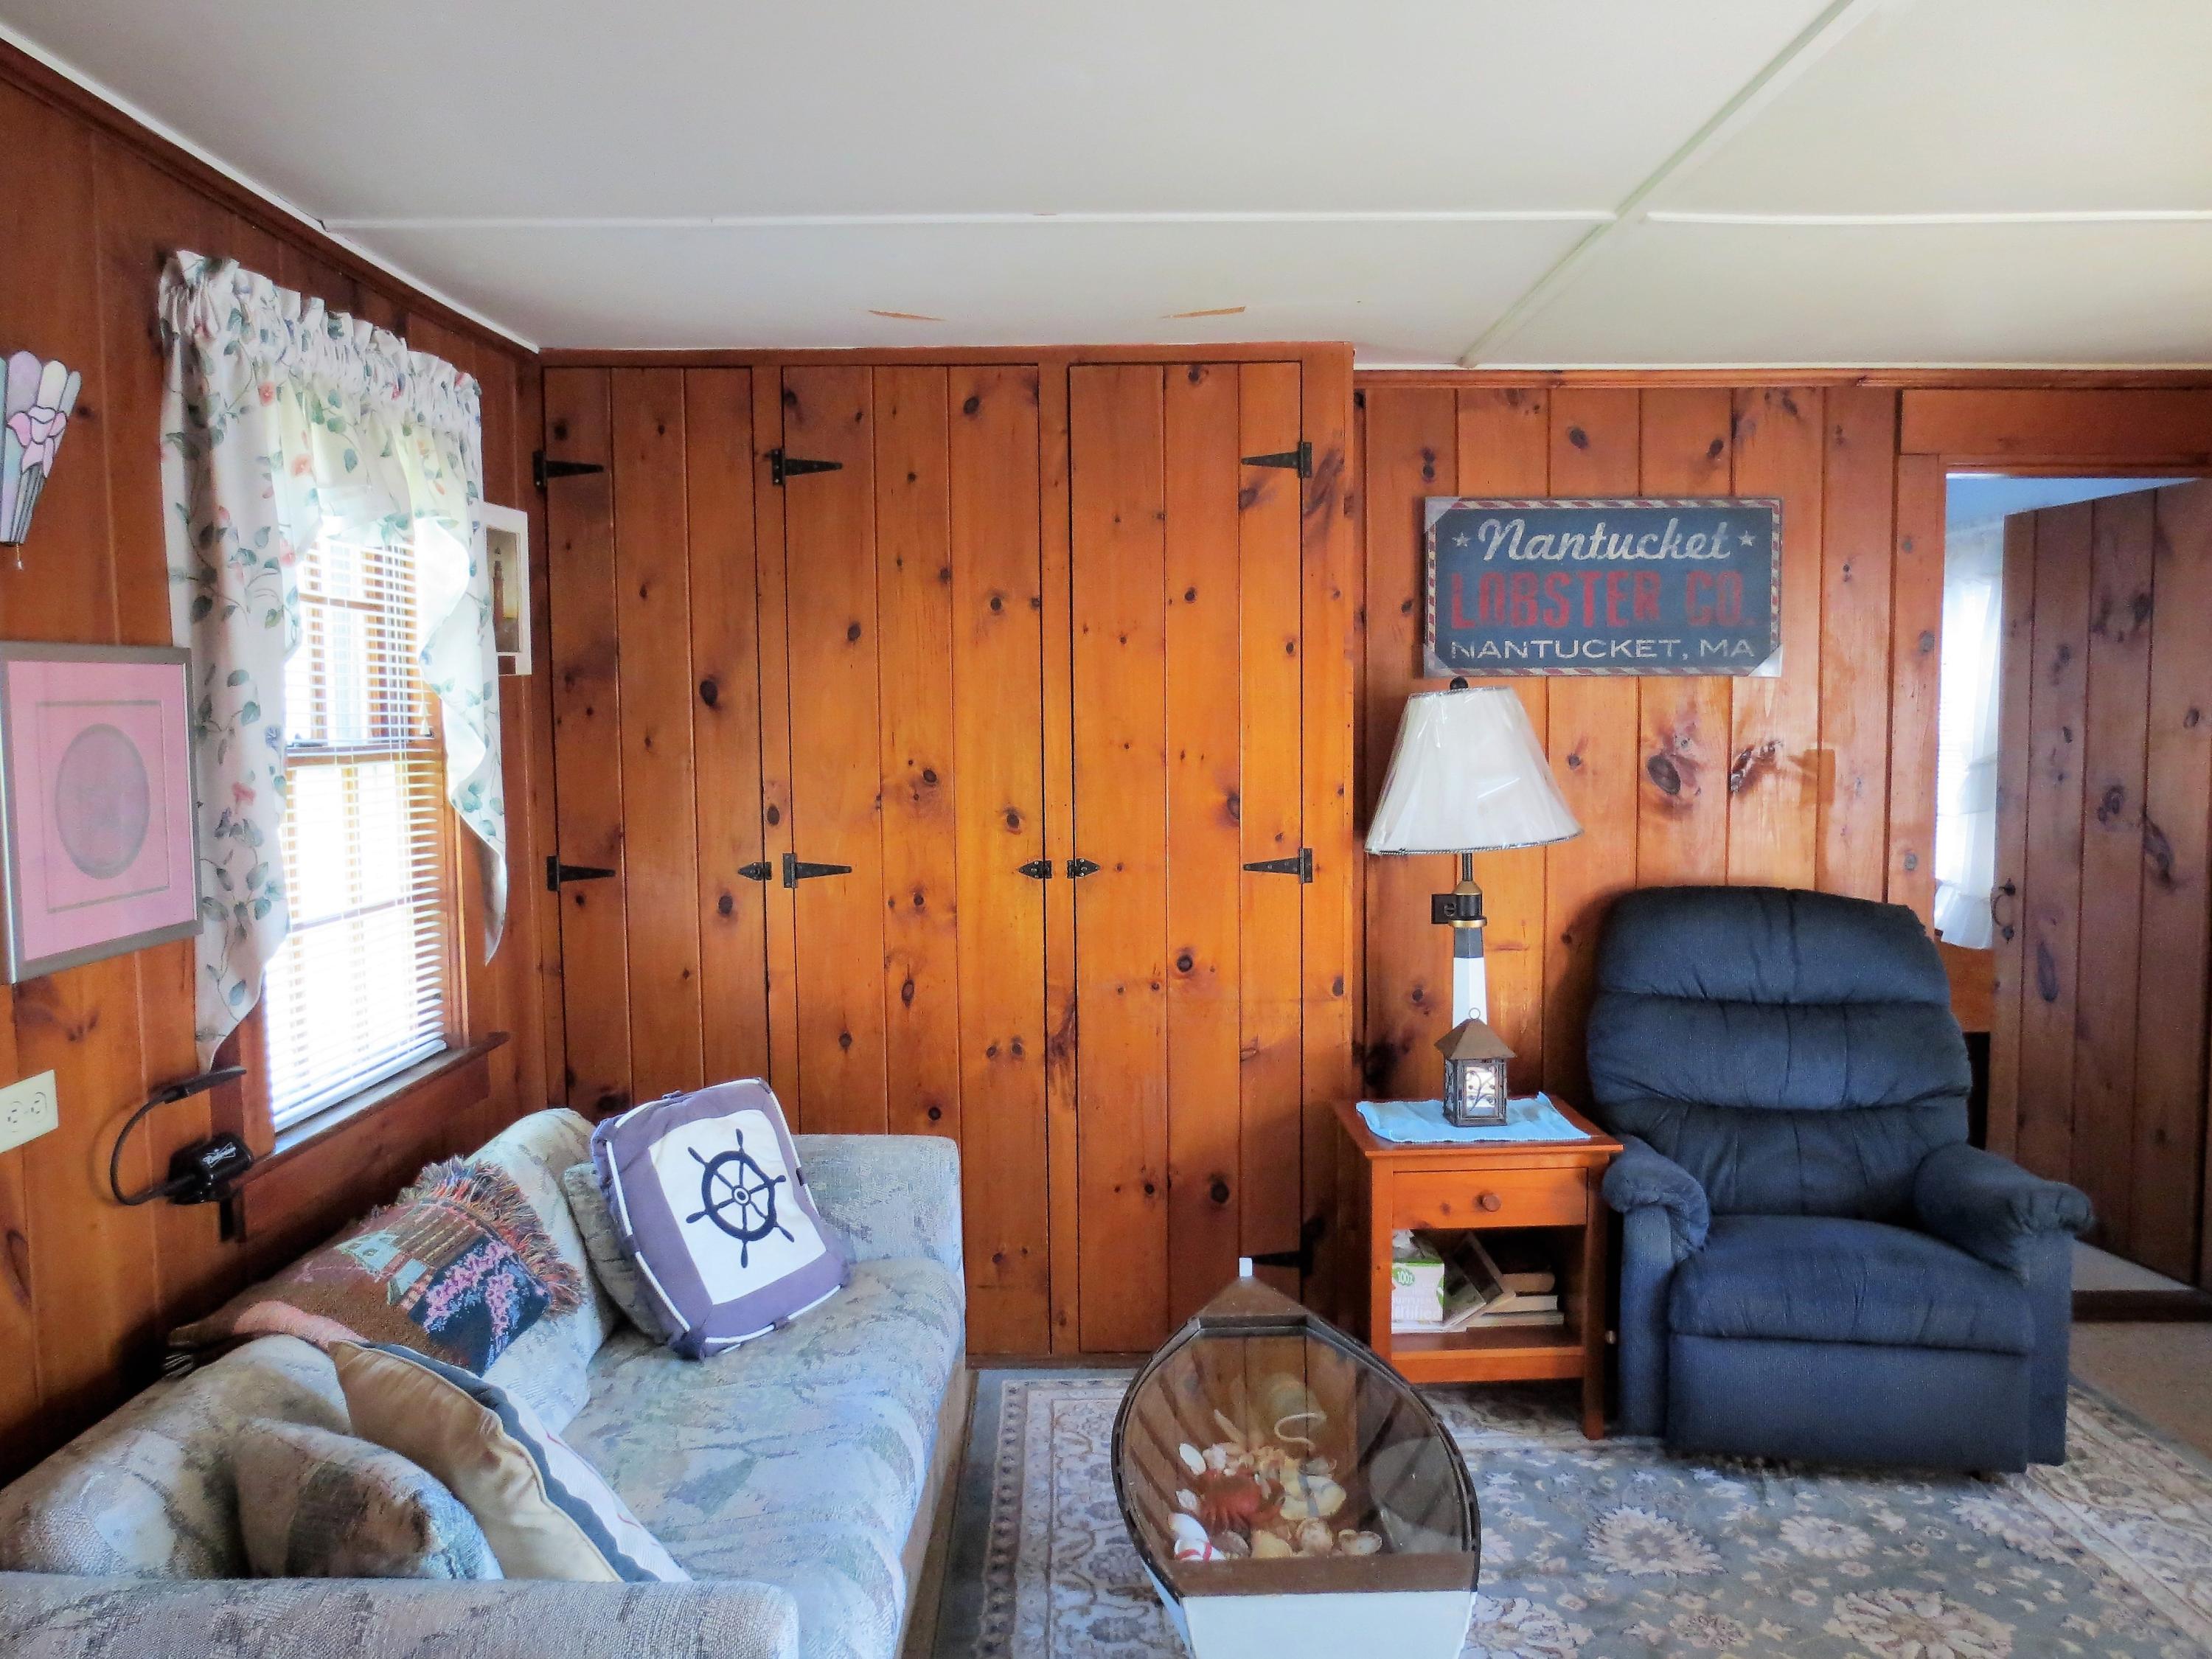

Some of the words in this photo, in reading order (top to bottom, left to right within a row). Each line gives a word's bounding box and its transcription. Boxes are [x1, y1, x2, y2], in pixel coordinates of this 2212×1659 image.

[1478, 518, 1731, 560] Nantucket
[1451, 571, 1662, 629] LOBSTER
[1700, 639, 1755, 658] MA
